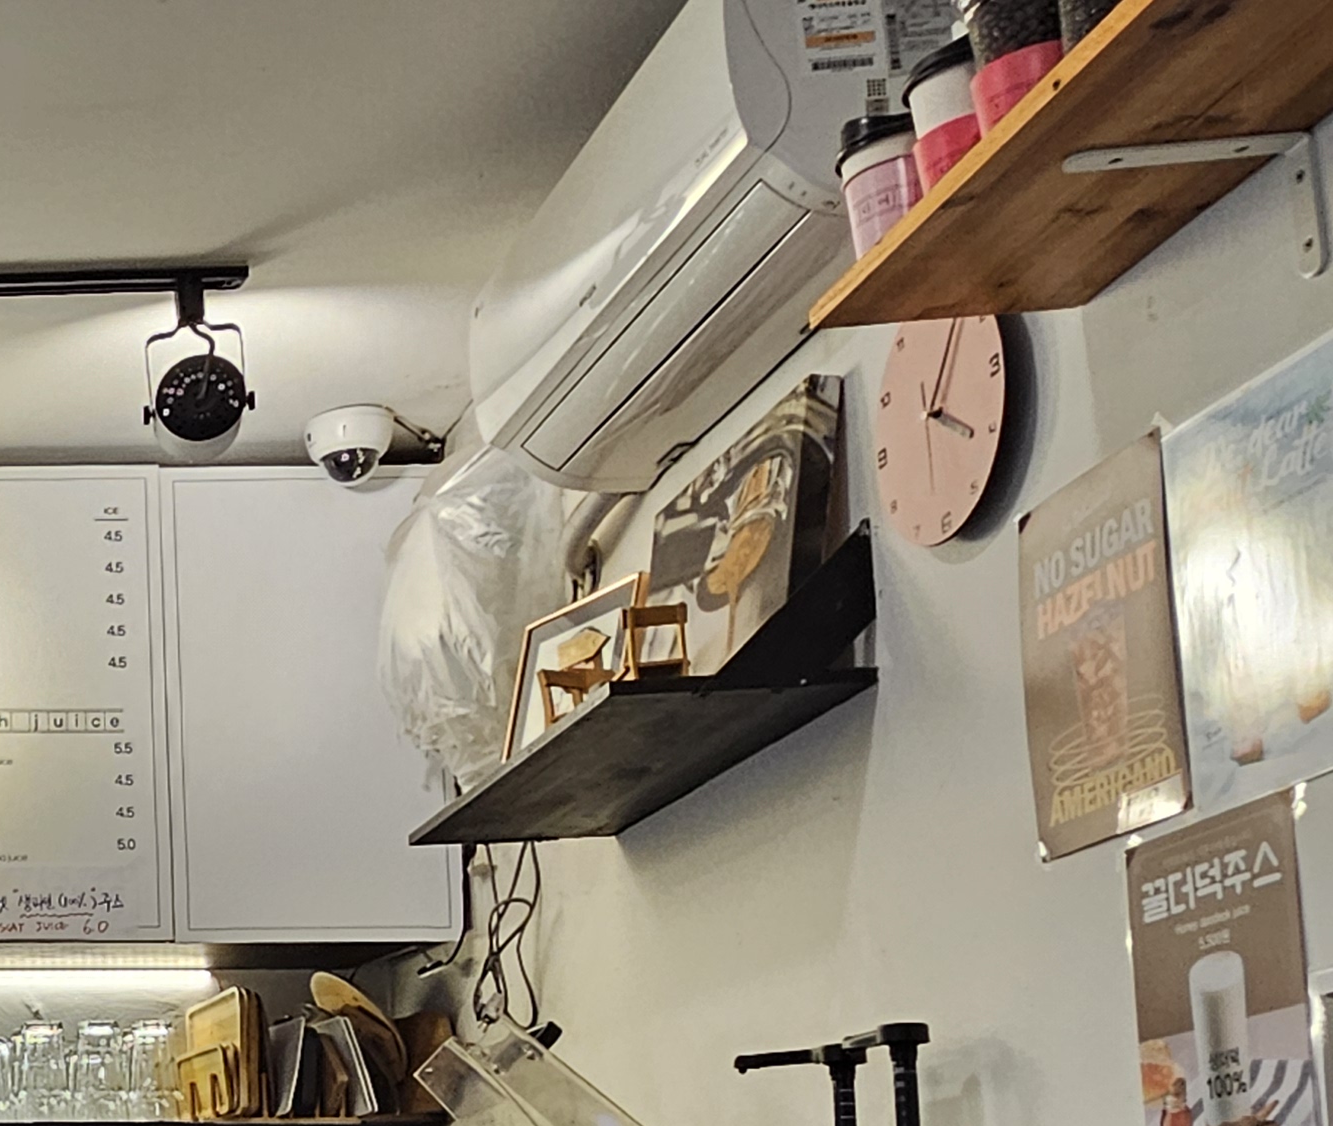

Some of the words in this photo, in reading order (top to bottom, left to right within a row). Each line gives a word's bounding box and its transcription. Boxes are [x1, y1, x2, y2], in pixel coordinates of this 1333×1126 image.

[103, 530, 123, 542] 4.5
[1033, 550, 1066, 596] NO
[1070, 501, 1154, 573] SUGAR
[105, 561, 124, 573] 4.5
[1036, 541, 1157, 640] HAZELNUT
[105, 593, 125, 605] 4.5
[106, 625, 126, 637] 4.5
[108, 656, 127, 669] 4.5
[32, 714, 121, 732] juice
[113, 742, 133, 754] 5.5
[114, 774, 134, 786] 4.5
[1049, 746, 1177, 828] AMERICANO
[115, 806, 135, 818] 4.5
[116, 838, 136, 850] 5.0
[1140, 840, 1283, 925] 꿀더덕주스
[1206, 1070, 1248, 1100] 100%
